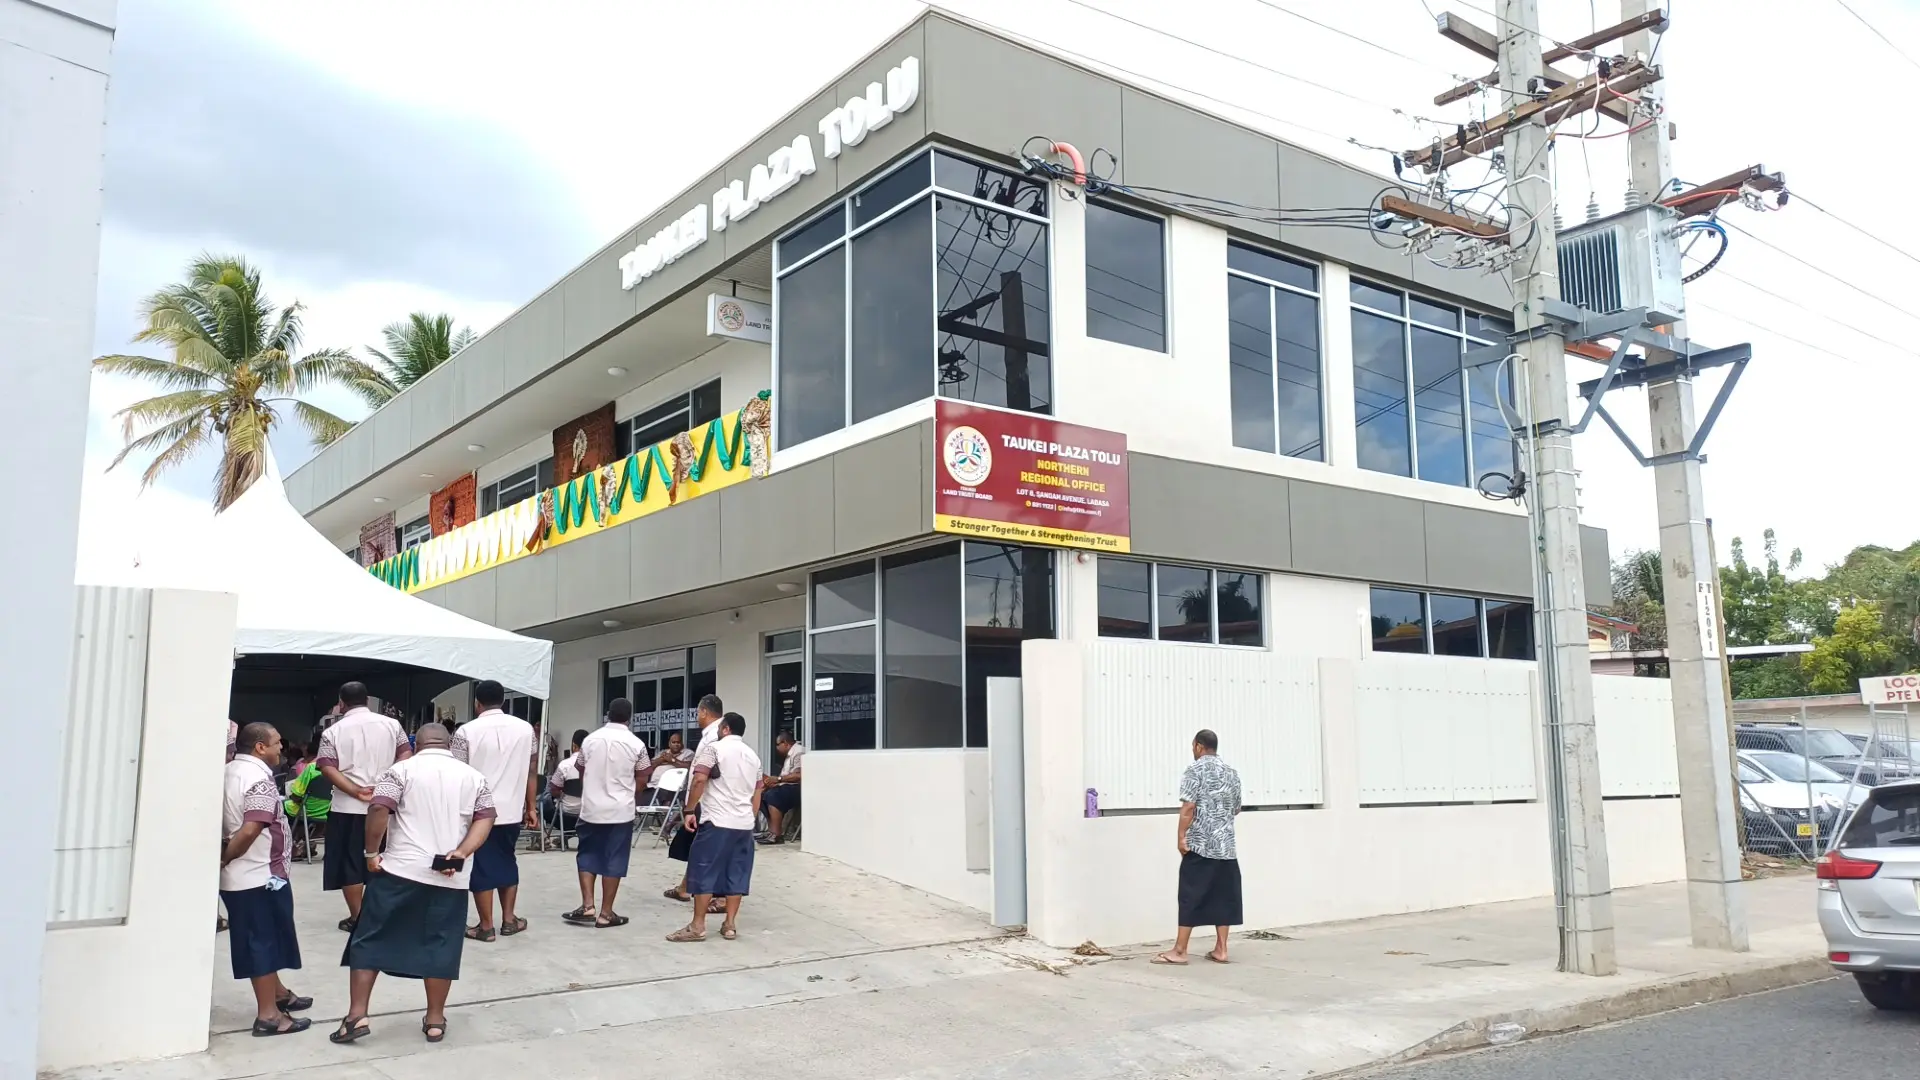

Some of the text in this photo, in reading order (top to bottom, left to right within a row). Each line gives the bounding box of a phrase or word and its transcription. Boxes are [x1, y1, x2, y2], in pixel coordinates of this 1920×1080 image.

[618, 55, 919, 291] TAUKEI PLAZA TOLU
[1001, 434, 1121, 465] TAUKEI PLAZA TOLU
[1037, 459, 1090, 477] NORTHERN
[1020, 471, 1106, 493] REGIONAL OFFICE
[1016, 488, 1028, 496] LOT
[950, 519, 1118, 547] Stronger Together & Strengthening Trust
[1698, 582, 1712, 594] FT
[1883, 676, 1920, 689] LOC
[1886, 690, 1912, 701] PTE
